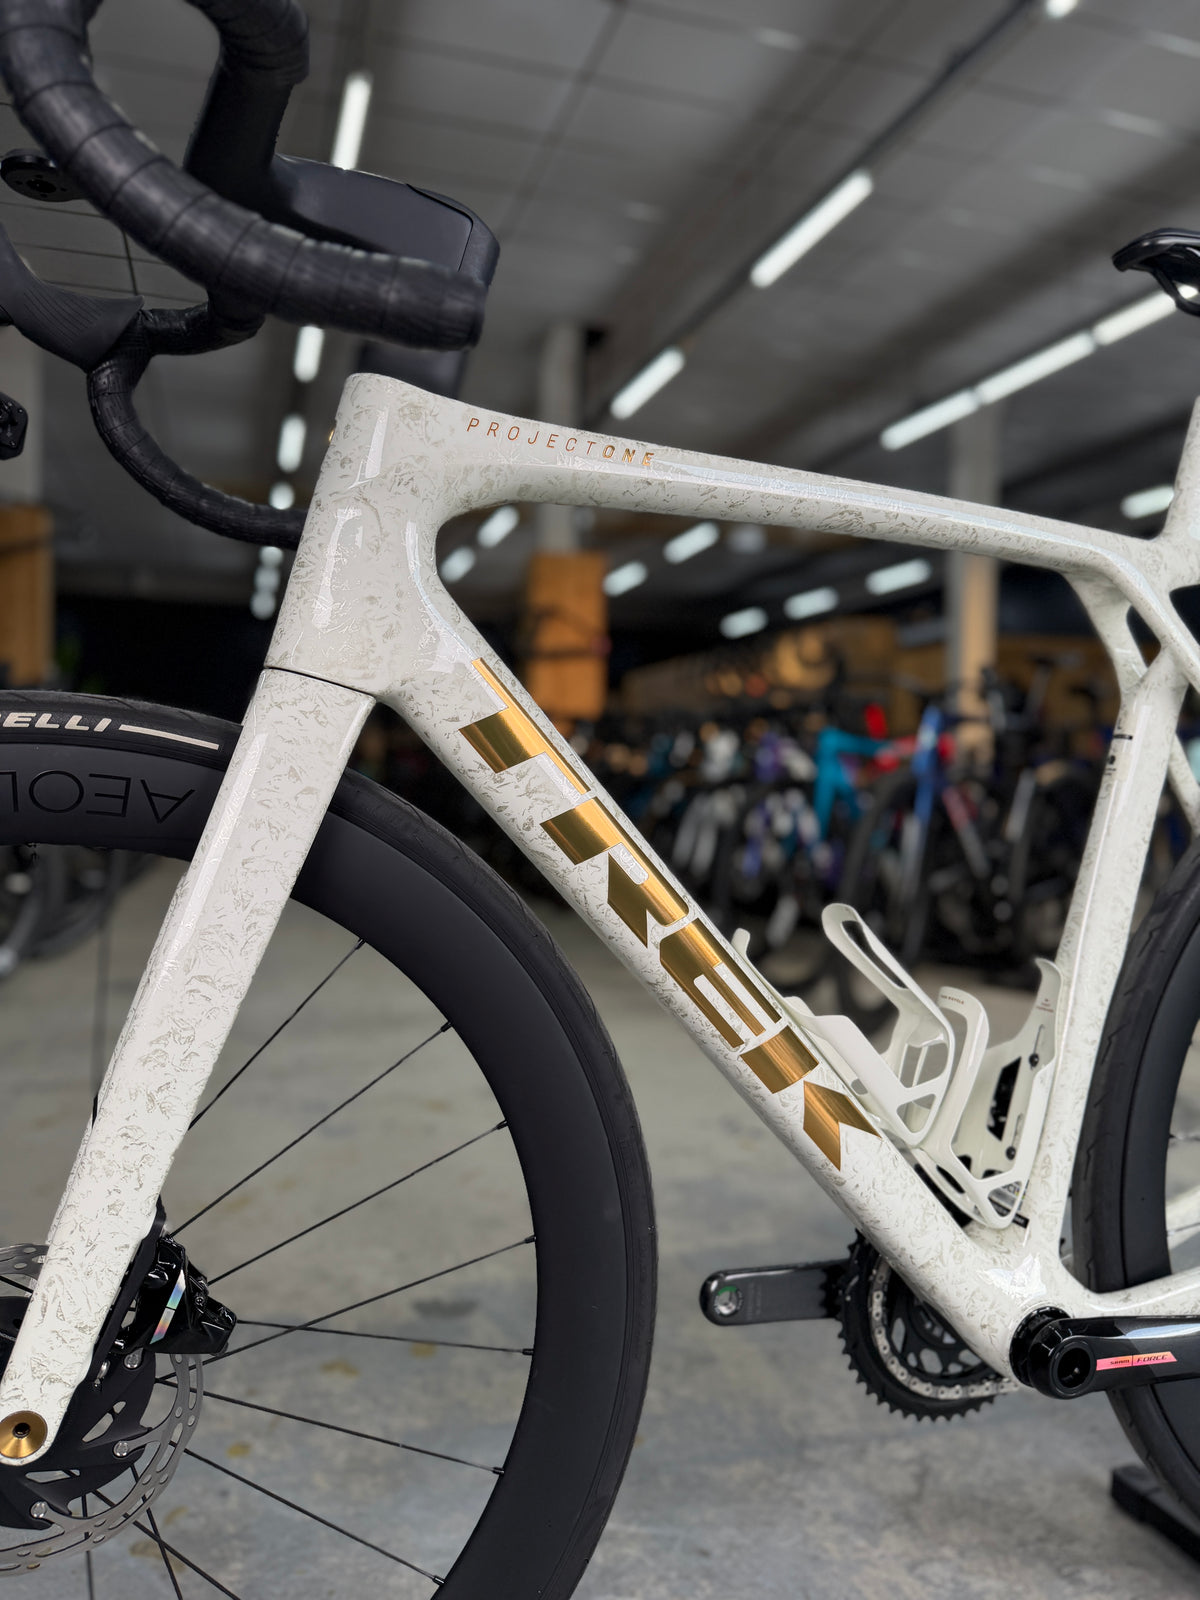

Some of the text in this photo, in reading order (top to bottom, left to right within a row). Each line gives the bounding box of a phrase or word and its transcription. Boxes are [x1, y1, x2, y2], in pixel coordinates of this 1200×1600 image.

[0, 712, 112, 732] ELLI
[458, 657, 883, 1172] TREK
[1136, 1354, 1168, 1363] FORCE
